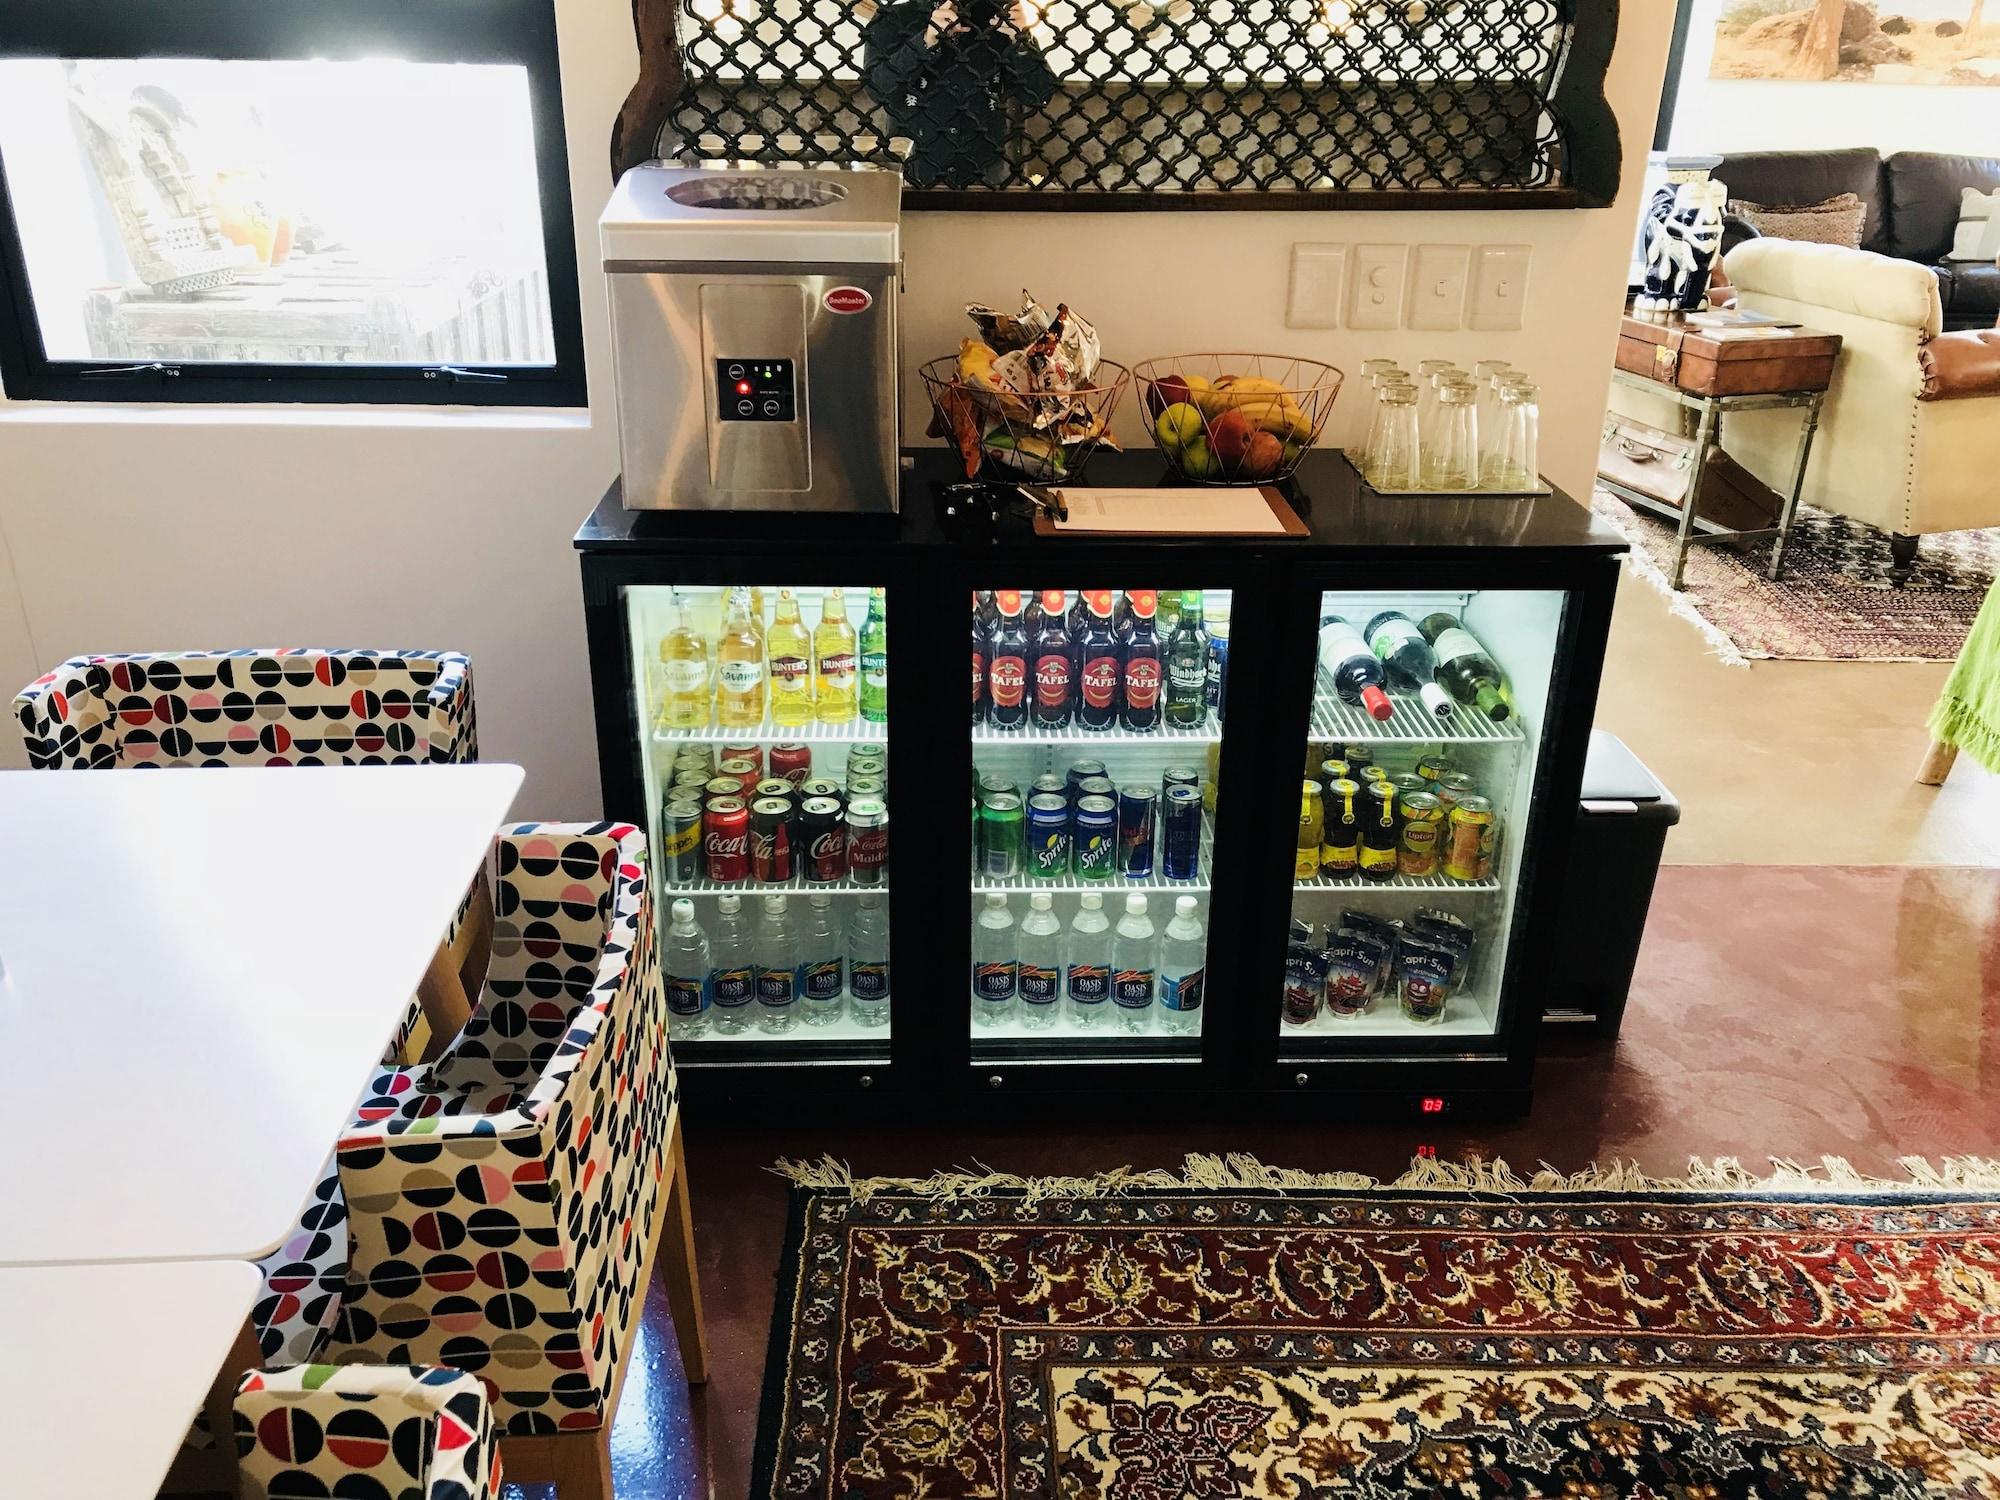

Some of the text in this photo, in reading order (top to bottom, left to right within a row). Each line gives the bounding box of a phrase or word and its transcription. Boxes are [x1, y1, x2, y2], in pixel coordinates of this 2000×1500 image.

[991, 672, 1024, 686] TAFEL
[1036, 672, 1069, 685] TAFEL
[1085, 674, 1117, 687] TAFEL
[1125, 674, 1159, 687] TAFEL
[1408, 831, 1432, 840] Lipton
[1081, 837, 1113, 869] Sprite
[988, 975, 1010, 984] OASIS
[1025, 979, 1048, 988] OASIS
[1079, 978, 1102, 988] OASIS
[721, 981, 744, 991] OASIS
[1124, 984, 1147, 993] OASIS
[1423, 1098, 1443, 1112] 03
